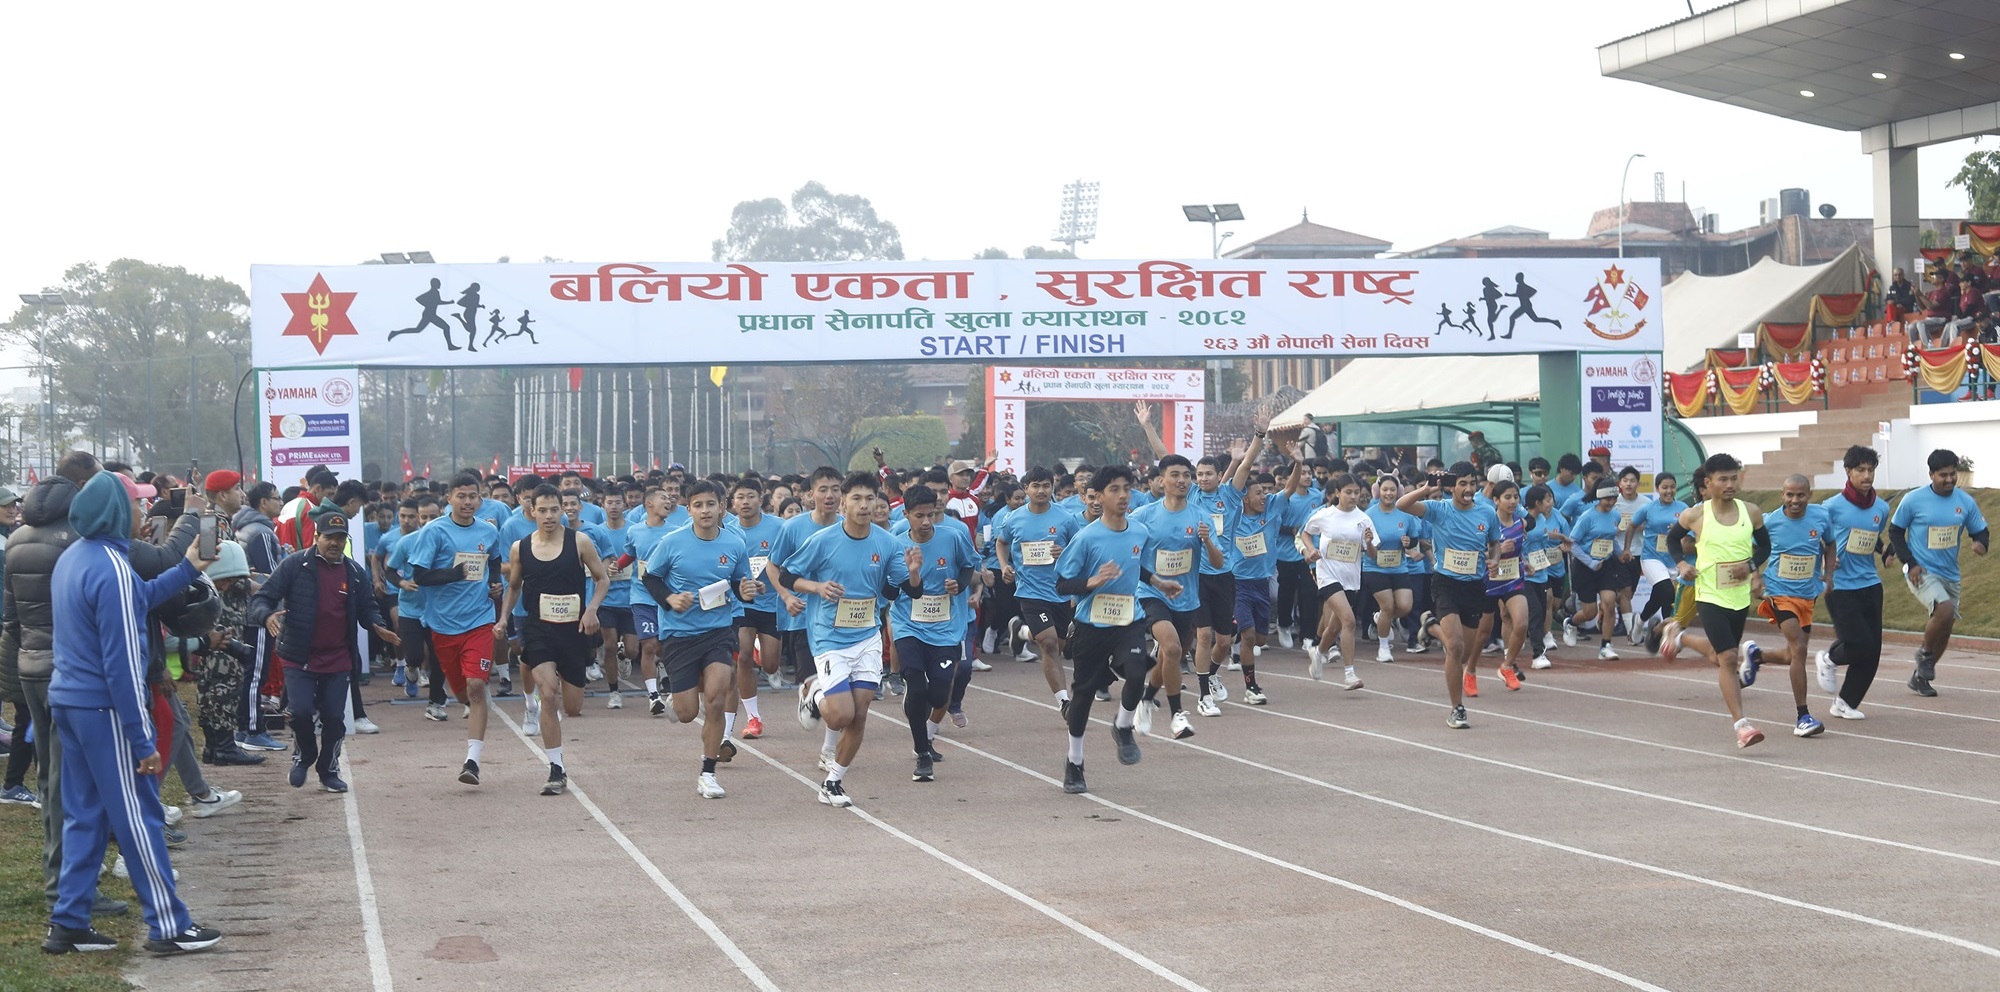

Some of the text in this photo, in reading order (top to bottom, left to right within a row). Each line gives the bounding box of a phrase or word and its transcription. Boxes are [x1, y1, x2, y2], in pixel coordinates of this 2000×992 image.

[550, 263, 768, 303] बलियो
[791, 271, 974, 302] एकता
[1036, 260, 1267, 306] सुरक्षित
[1288, 270, 1420, 306] राष्ट्र
[738, 314, 815, 333] प्रधान
[825, 307, 936, 331] सेनापति
[945, 312, 1012, 330] खुला
[1022, 310, 1148, 328] म्याराथन
[1178, 309, 1247, 326] २०८२
[920, 336, 1011, 356] START
[1036, 334, 1126, 354] FINISH
[1204, 338, 1240, 351] २६३
[1276, 334, 1335, 351] नेपाली
[1340, 334, 1378, 350] सेना
[1383, 334, 1430, 350] दिवस
[1022, 369, 1060, 379] बलियो
[1064, 371, 1096, 380] एकता
[1106, 370, 1148, 382] सुरक्षित
[1596, 366, 1628, 377] YAMAHA
[278, 388, 318, 400] YAMAHA
[1004, 403, 1014, 447] THANK
[1184, 406, 1194, 448] THANK
[1590, 440, 1614, 449] NIMB
[1039, 612, 1049, 622] 15
[1103, 608, 1120, 616] 1363
[642, 621, 655, 633] 21
